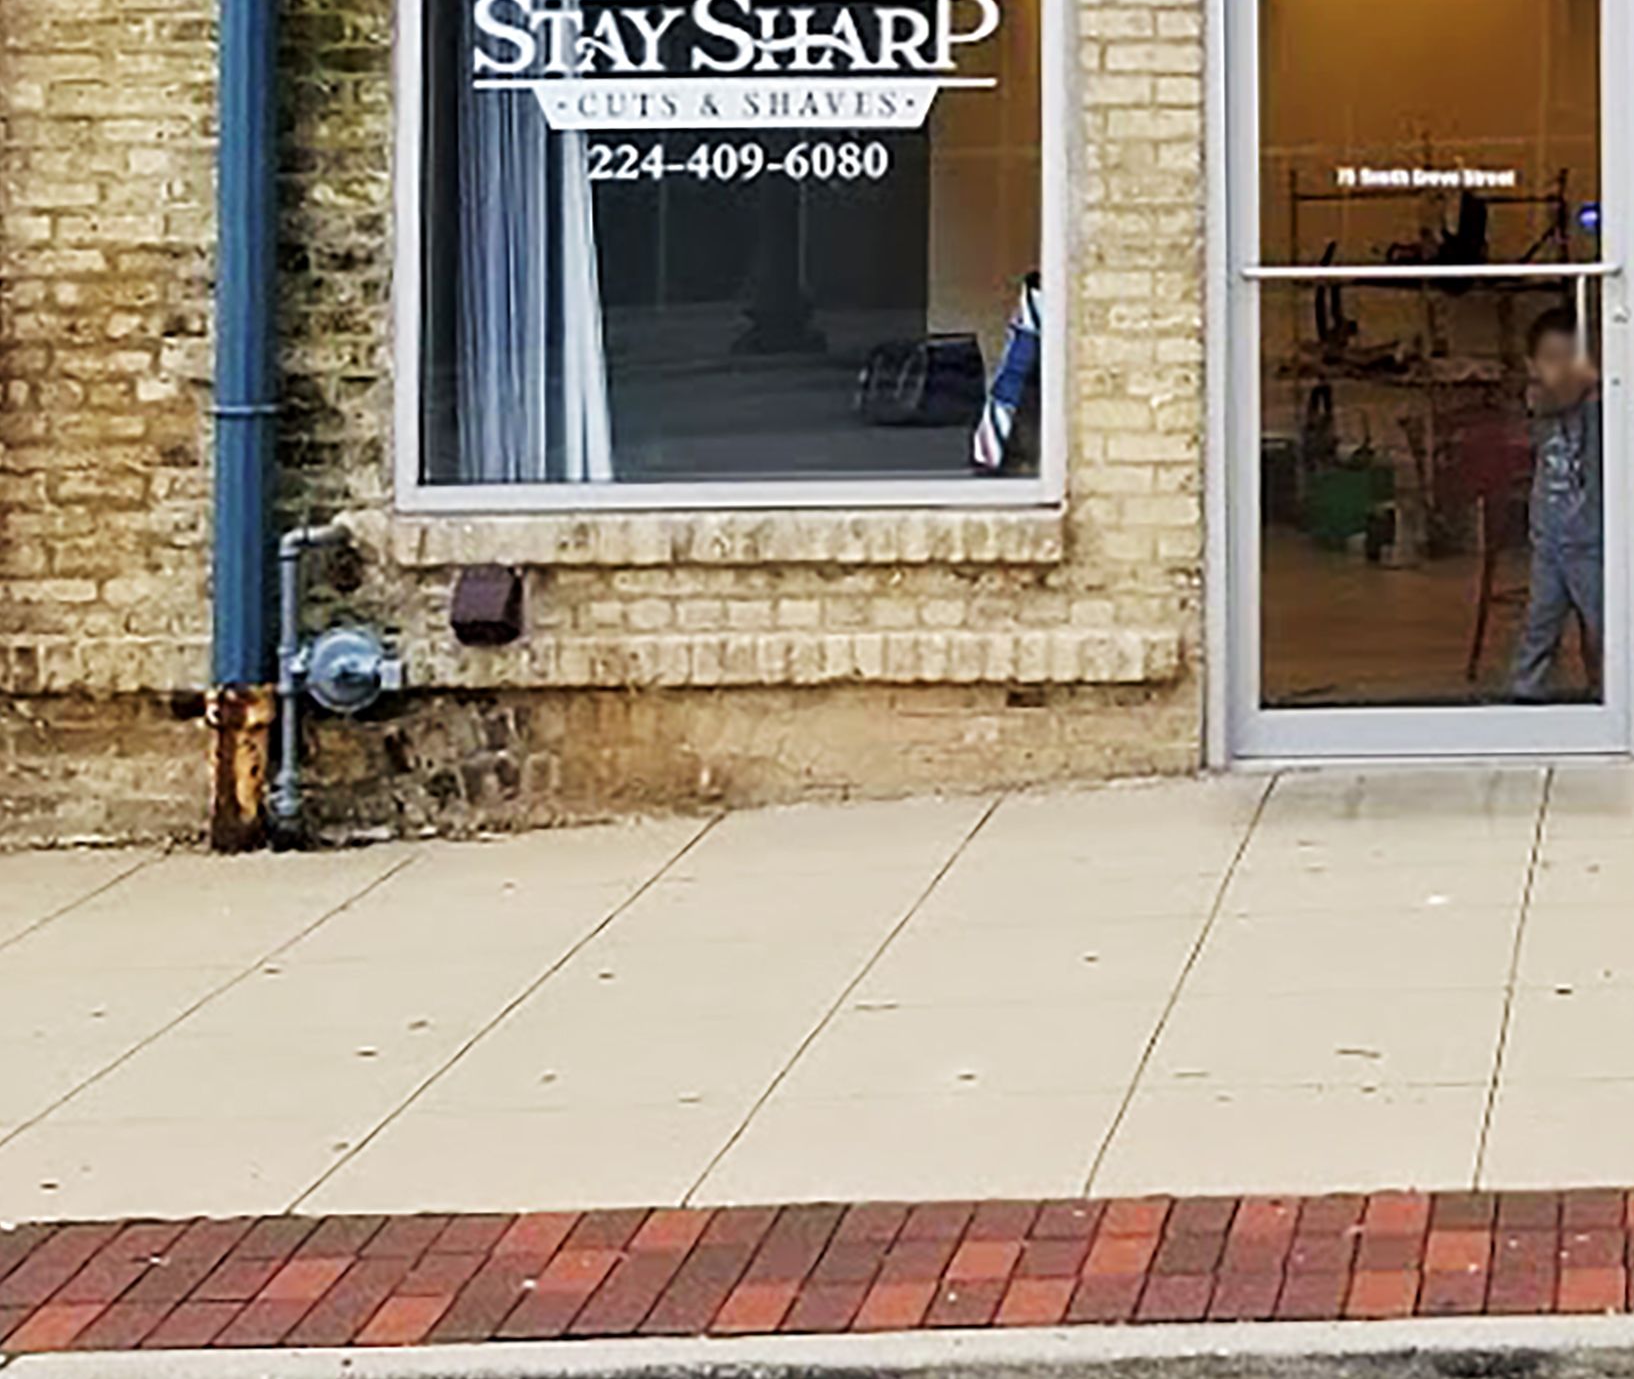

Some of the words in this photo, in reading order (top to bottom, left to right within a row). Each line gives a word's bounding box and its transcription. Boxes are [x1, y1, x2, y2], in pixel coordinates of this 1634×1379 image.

[578, 92, 679, 118] CUTS
[699, 93, 722, 117] &
[743, 91, 898, 117] SHAVES
[588, 142, 890, 180] 224-409-6080
